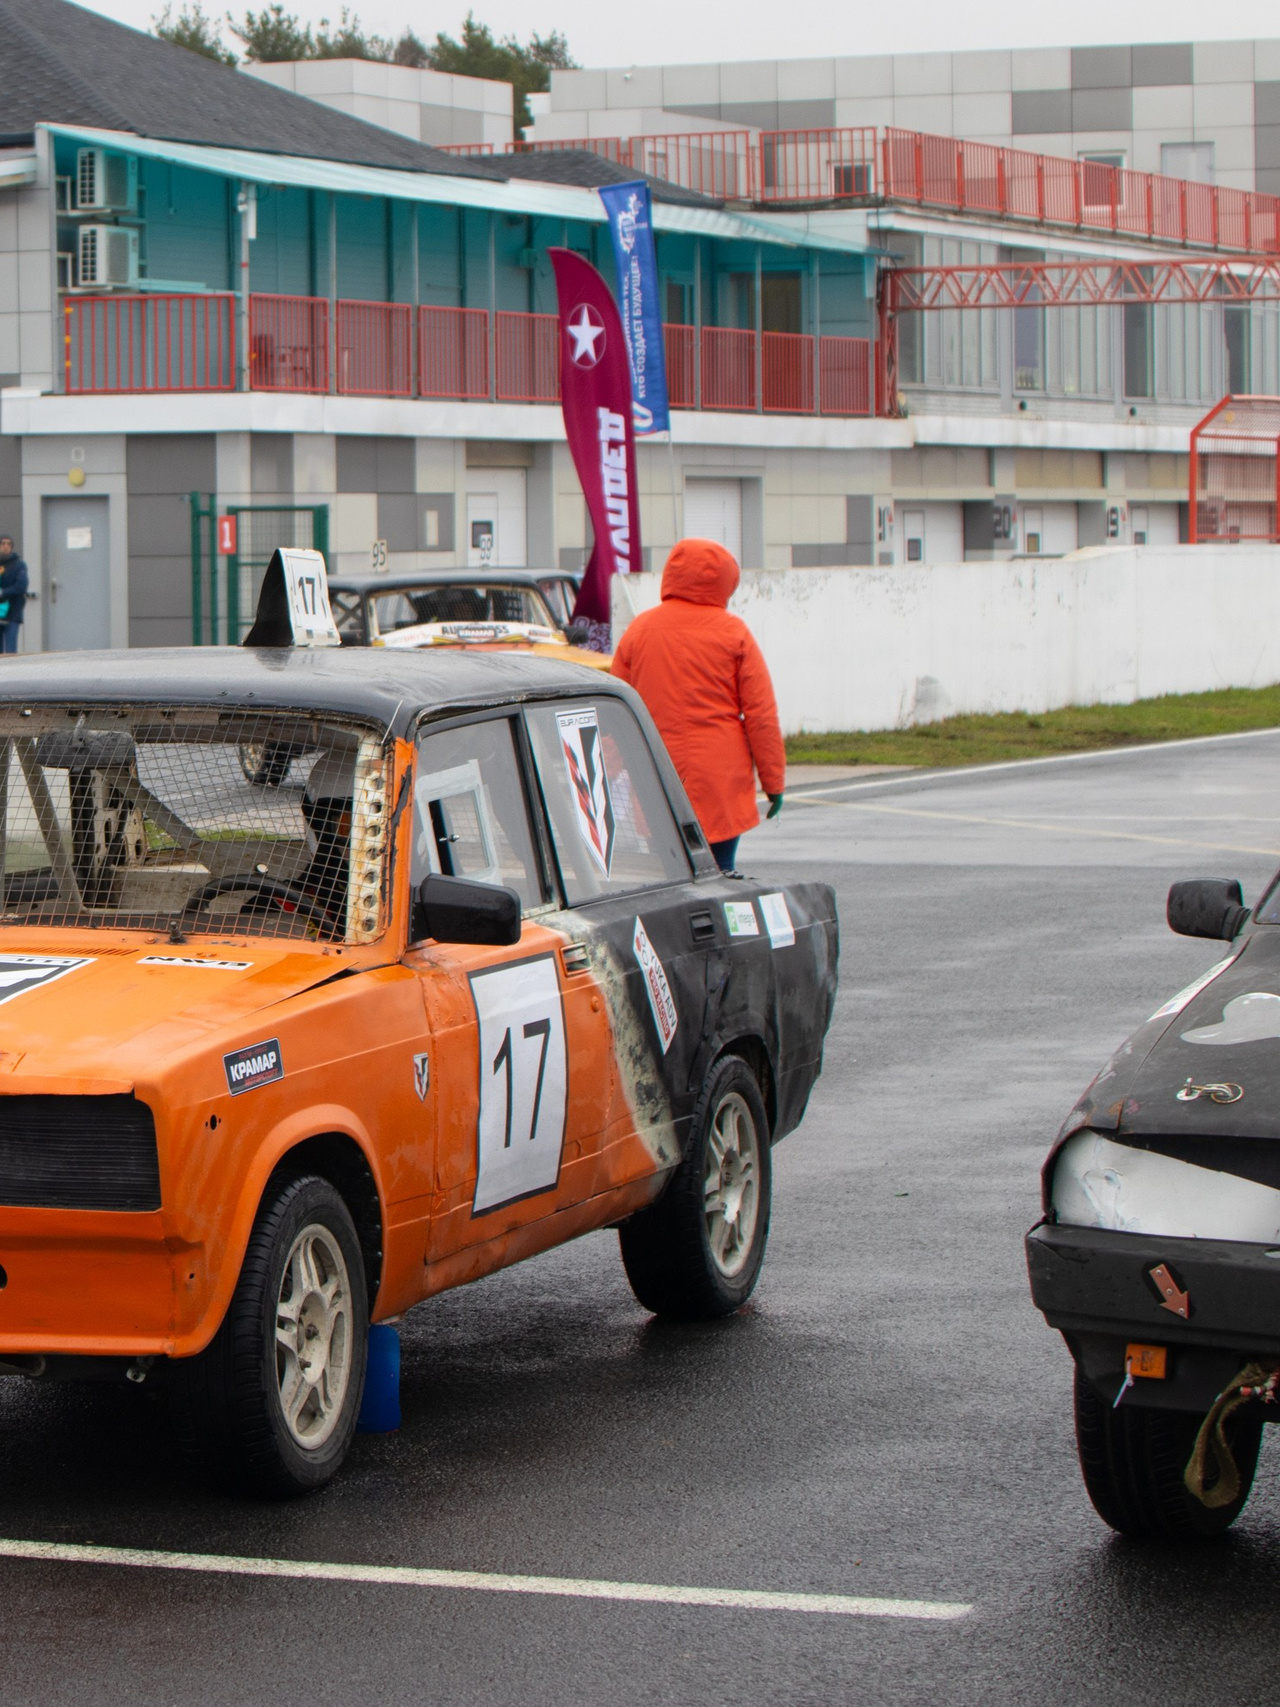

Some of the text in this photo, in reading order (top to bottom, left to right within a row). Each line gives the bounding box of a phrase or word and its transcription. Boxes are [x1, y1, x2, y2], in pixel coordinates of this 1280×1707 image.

[222, 521, 232, 549] 1
[994, 505, 1011, 538] 20
[298, 576, 316, 615] 17
[230, 1051, 277, 1082] КРАМАР
[492, 1018, 551, 1148] 17
